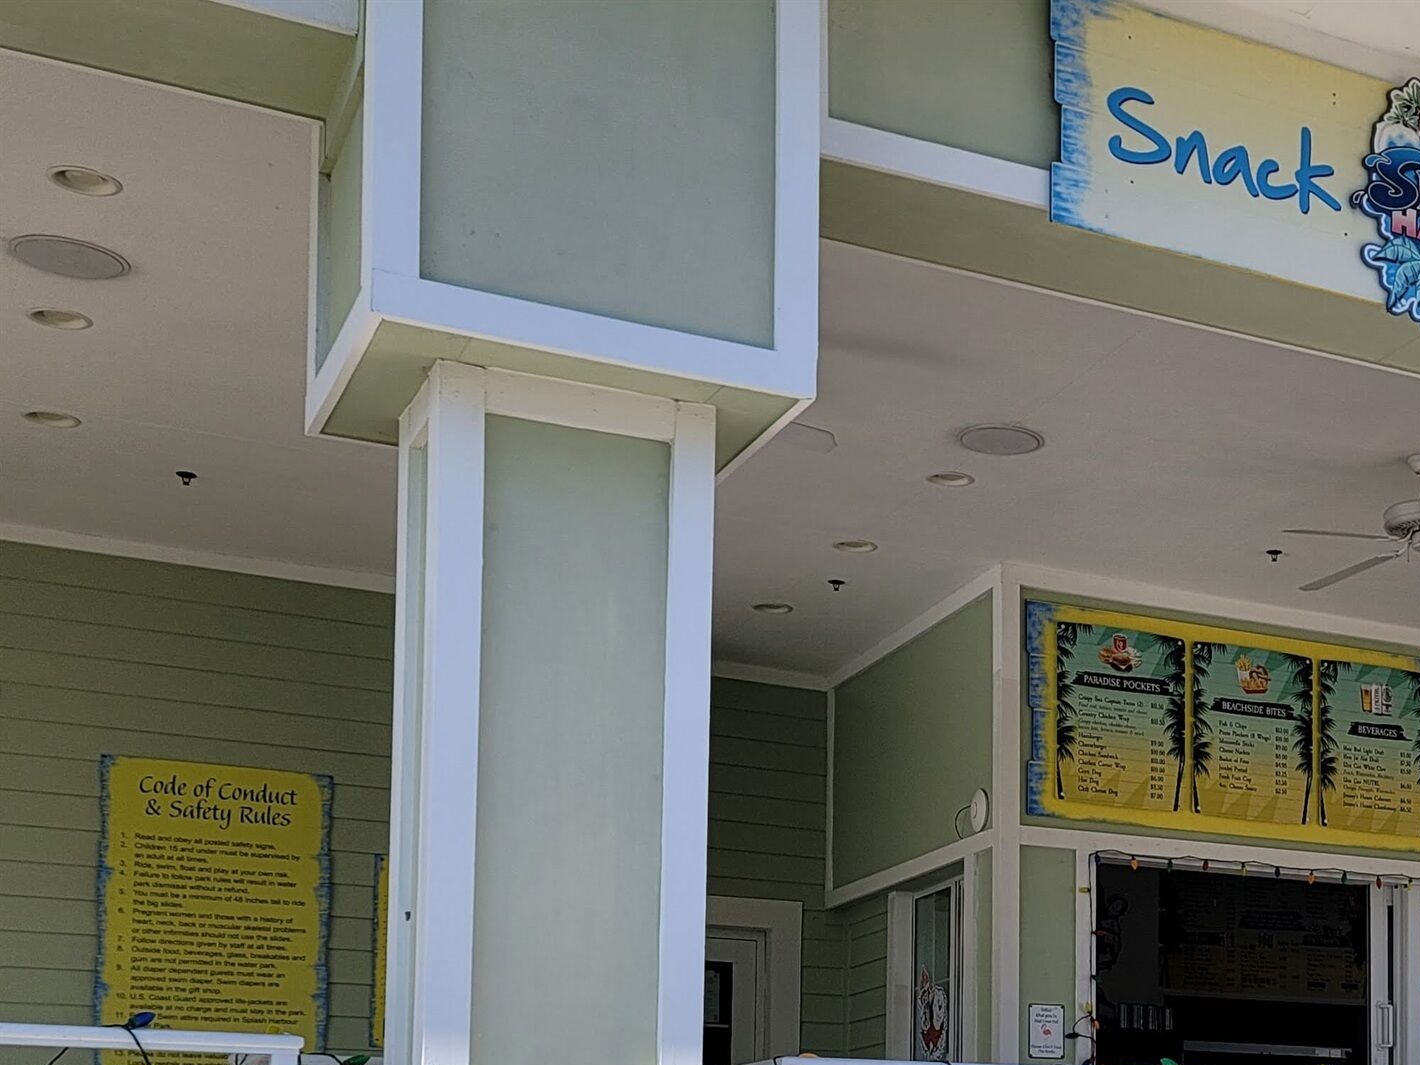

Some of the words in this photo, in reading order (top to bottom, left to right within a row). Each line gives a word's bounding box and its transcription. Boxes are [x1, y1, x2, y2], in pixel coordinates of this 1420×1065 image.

[1107, 86, 1343, 214] Snack
[1084, 675, 1120, 687] PARADISE
[1123, 681, 1161, 692] POCKETS
[1222, 701, 1264, 714] BEACHSIDE
[1266, 707, 1286, 717] BITES
[1358, 725, 1397, 737] BEVERAGES
[139, 775, 186, 796] Code
[193, 778, 216, 797] of
[219, 783, 297, 805] Conduct
[145, 798, 161, 815] &
[169, 799, 231, 830] Safety
[240, 806, 292, 826] Rules
